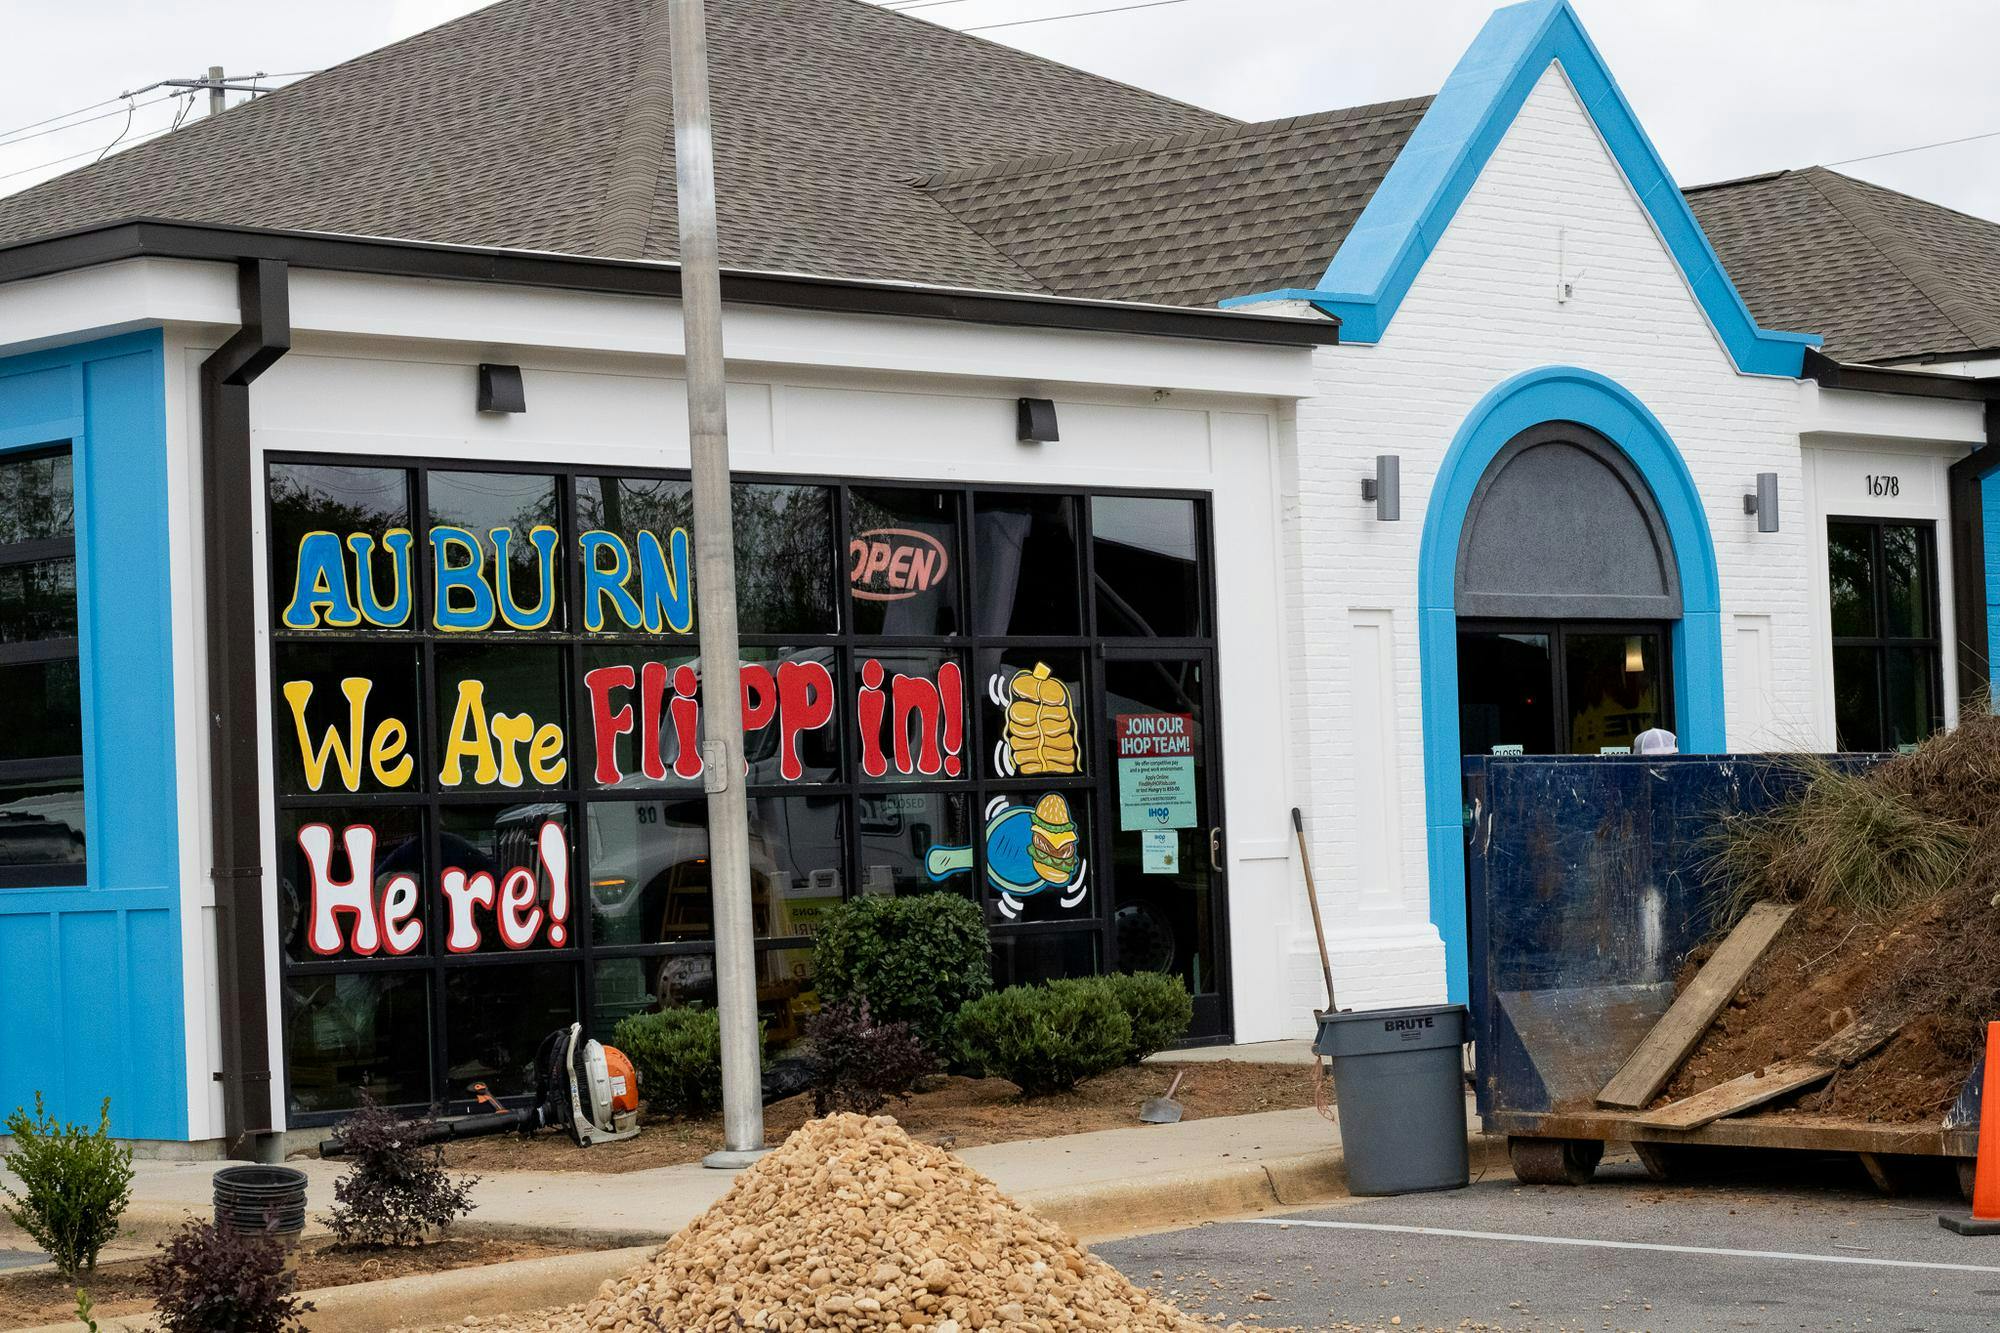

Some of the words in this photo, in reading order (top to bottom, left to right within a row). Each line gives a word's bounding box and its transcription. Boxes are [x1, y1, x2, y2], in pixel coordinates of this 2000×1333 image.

[1865, 475, 1900, 496] 1678
[282, 525, 693, 633] AUBURN
[850, 539, 937, 591] OPEN
[282, 676, 414, 791] We
[439, 679, 567, 788] Are
[1126, 718, 1155, 735] JOIN
[1156, 717, 1184, 734] OUR
[1121, 737, 1151, 755] IHOP
[1153, 736, 1190, 753] TEAM!
[299, 820, 570, 955] Here!
[1384, 1016, 1435, 1032] BRUTE
